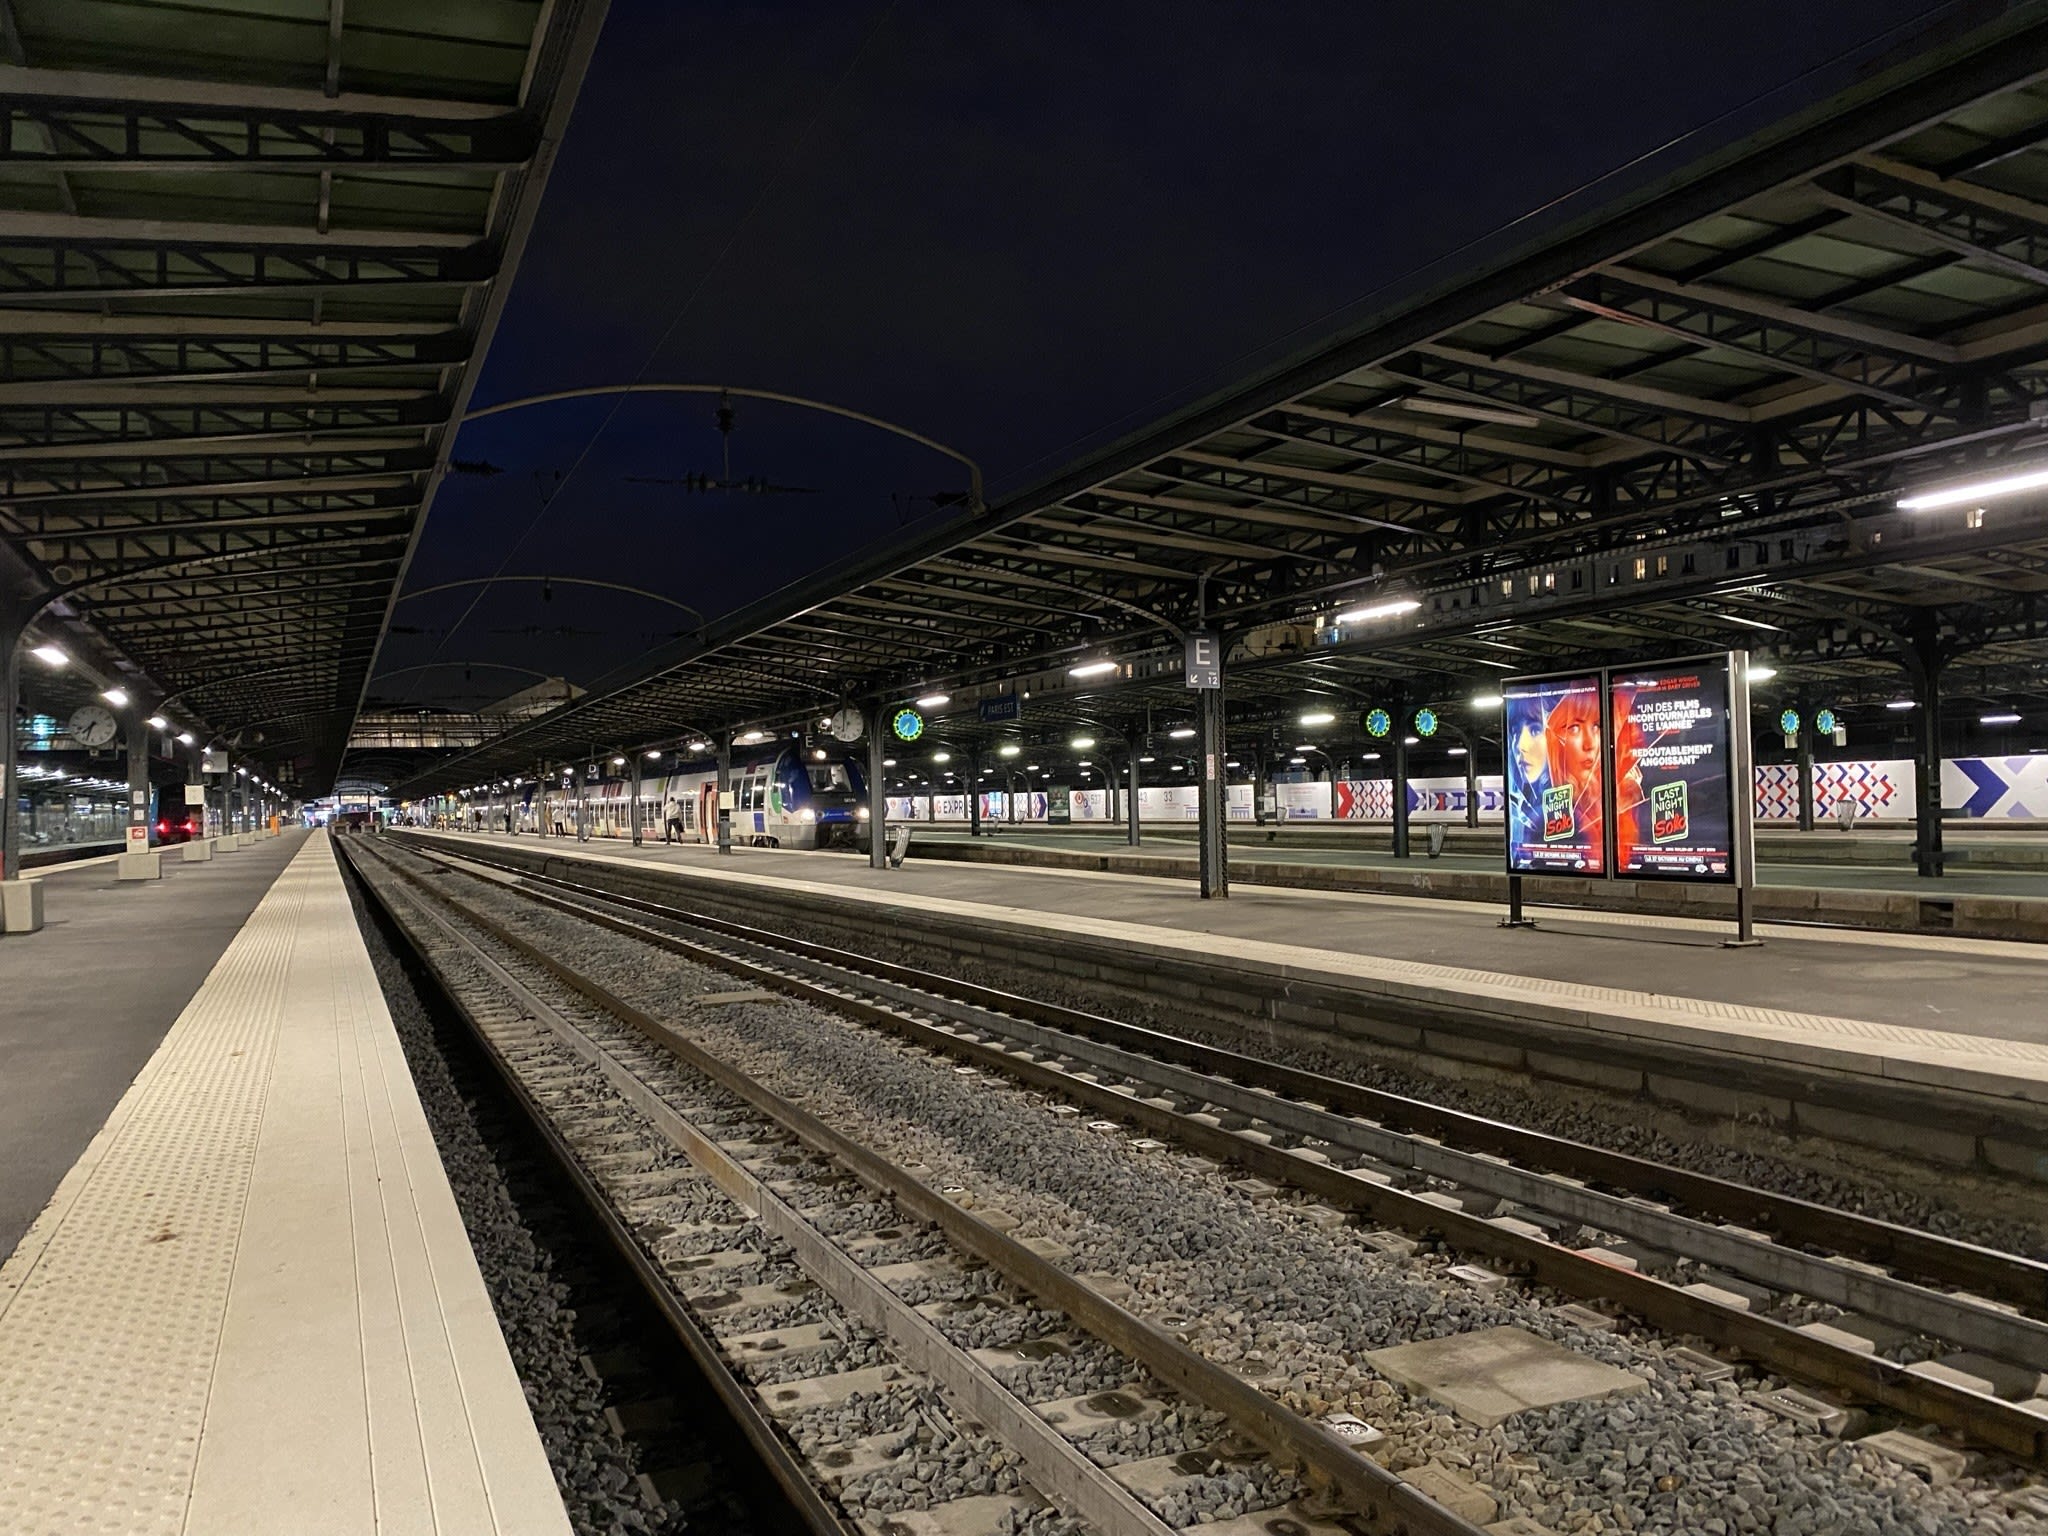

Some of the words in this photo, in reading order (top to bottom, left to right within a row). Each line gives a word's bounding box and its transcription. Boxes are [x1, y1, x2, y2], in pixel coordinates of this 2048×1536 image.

[1196, 639, 1210, 664] E
[1208, 676, 1218, 685] 12
[1655, 701, 1673, 712] DES
[1674, 699, 1700, 711] FILMS
[1628, 708, 1712, 723] INCONTOURNABLES
[1642, 722, 1655, 732] DE
[805, 735, 814, 748] E
[1146, 736, 1154, 749] E
[588, 764, 597, 773] D
[1163, 790, 1173, 802] 33
[1548, 789, 1568, 803] LAST
[1658, 787, 1680, 801] LAST
[1546, 798, 1570, 813] NIGHT
[1655, 797, 1683, 813] NIGHT
[1554, 810, 1563, 820] IN
[1664, 809, 1675, 820] IN
